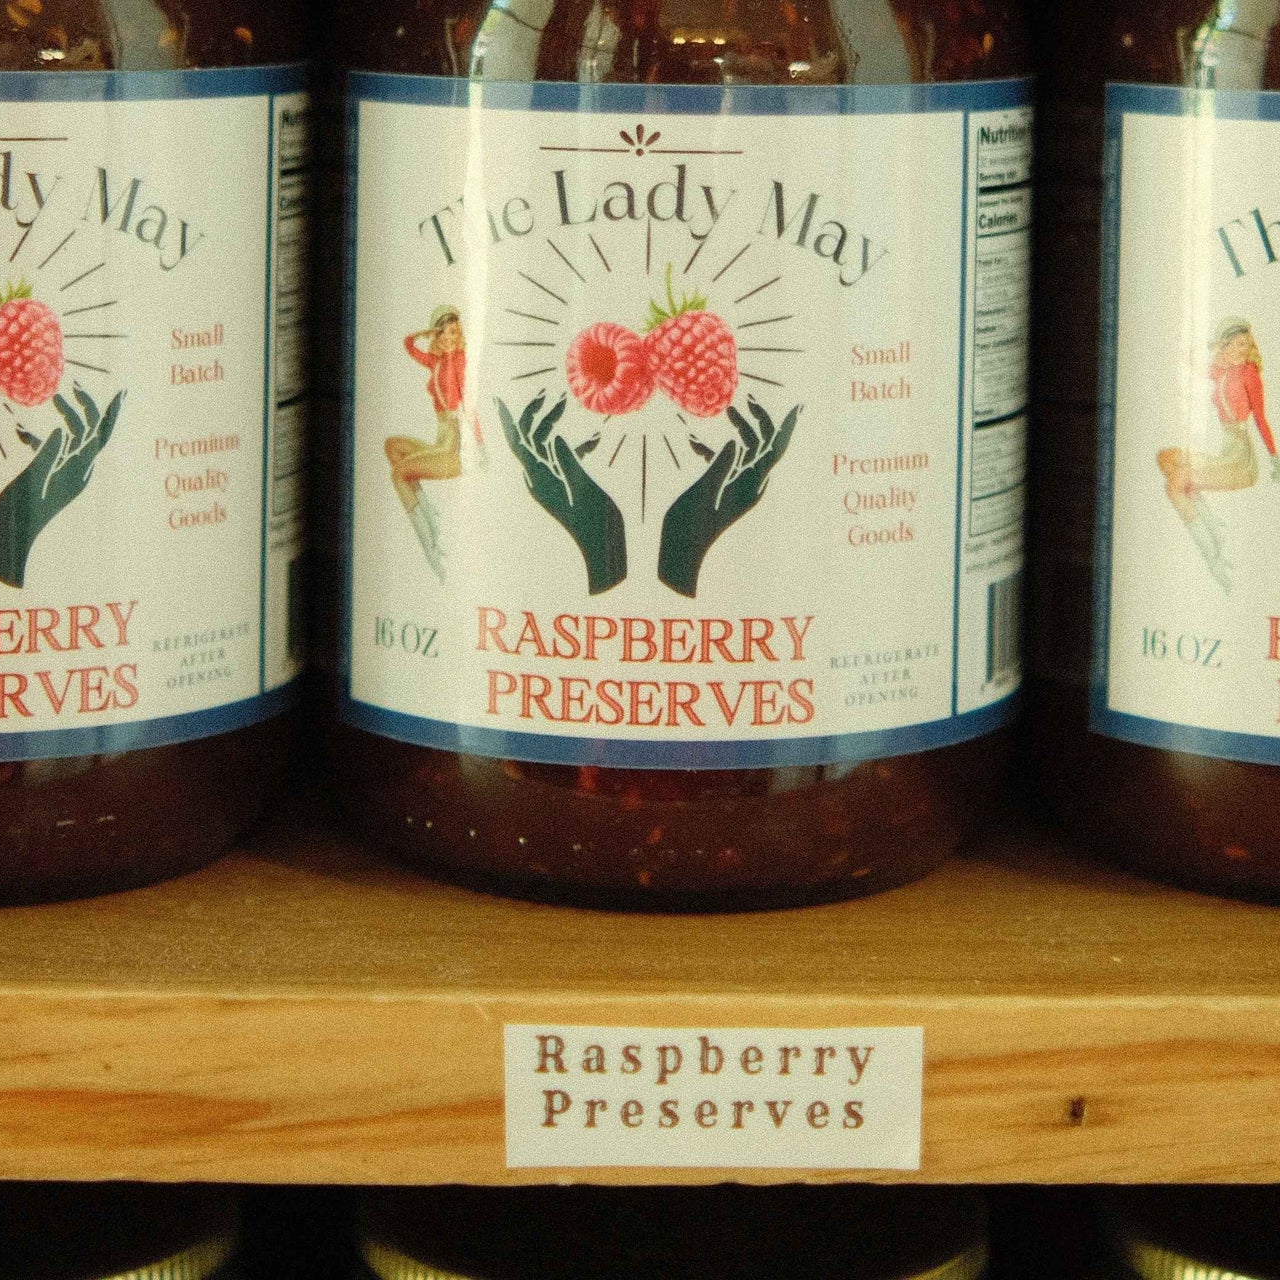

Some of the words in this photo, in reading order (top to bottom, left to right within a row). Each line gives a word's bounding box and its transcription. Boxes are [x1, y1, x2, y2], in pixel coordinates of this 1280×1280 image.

[82, 166, 210, 273] May
[552, 164, 735, 241] Lady
[758, 180, 889, 286] May
[172, 324, 224, 349] Small
[851, 341, 911, 366] Small
[171, 359, 224, 385] Batch
[851, 378, 912, 402] Batch
[155, 433, 240, 460] Premium
[833, 452, 930, 476] Premium
[165, 469, 228, 498] Quality
[843, 486, 916, 515] Quality
[169, 502, 227, 531] Goods
[848, 521, 914, 547] Goods
[373, 616, 398, 649] 16
[401, 626, 439, 659] OZ
[475, 606, 815, 665] RASPBERRY
[1141, 627, 1168, 661] 16
[1177, 636, 1223, 670] OZ
[486, 669, 815, 728] PRESERVES
[535, 1033, 874, 1085] Raspberry
[541, 1088, 866, 1130] Preserves
